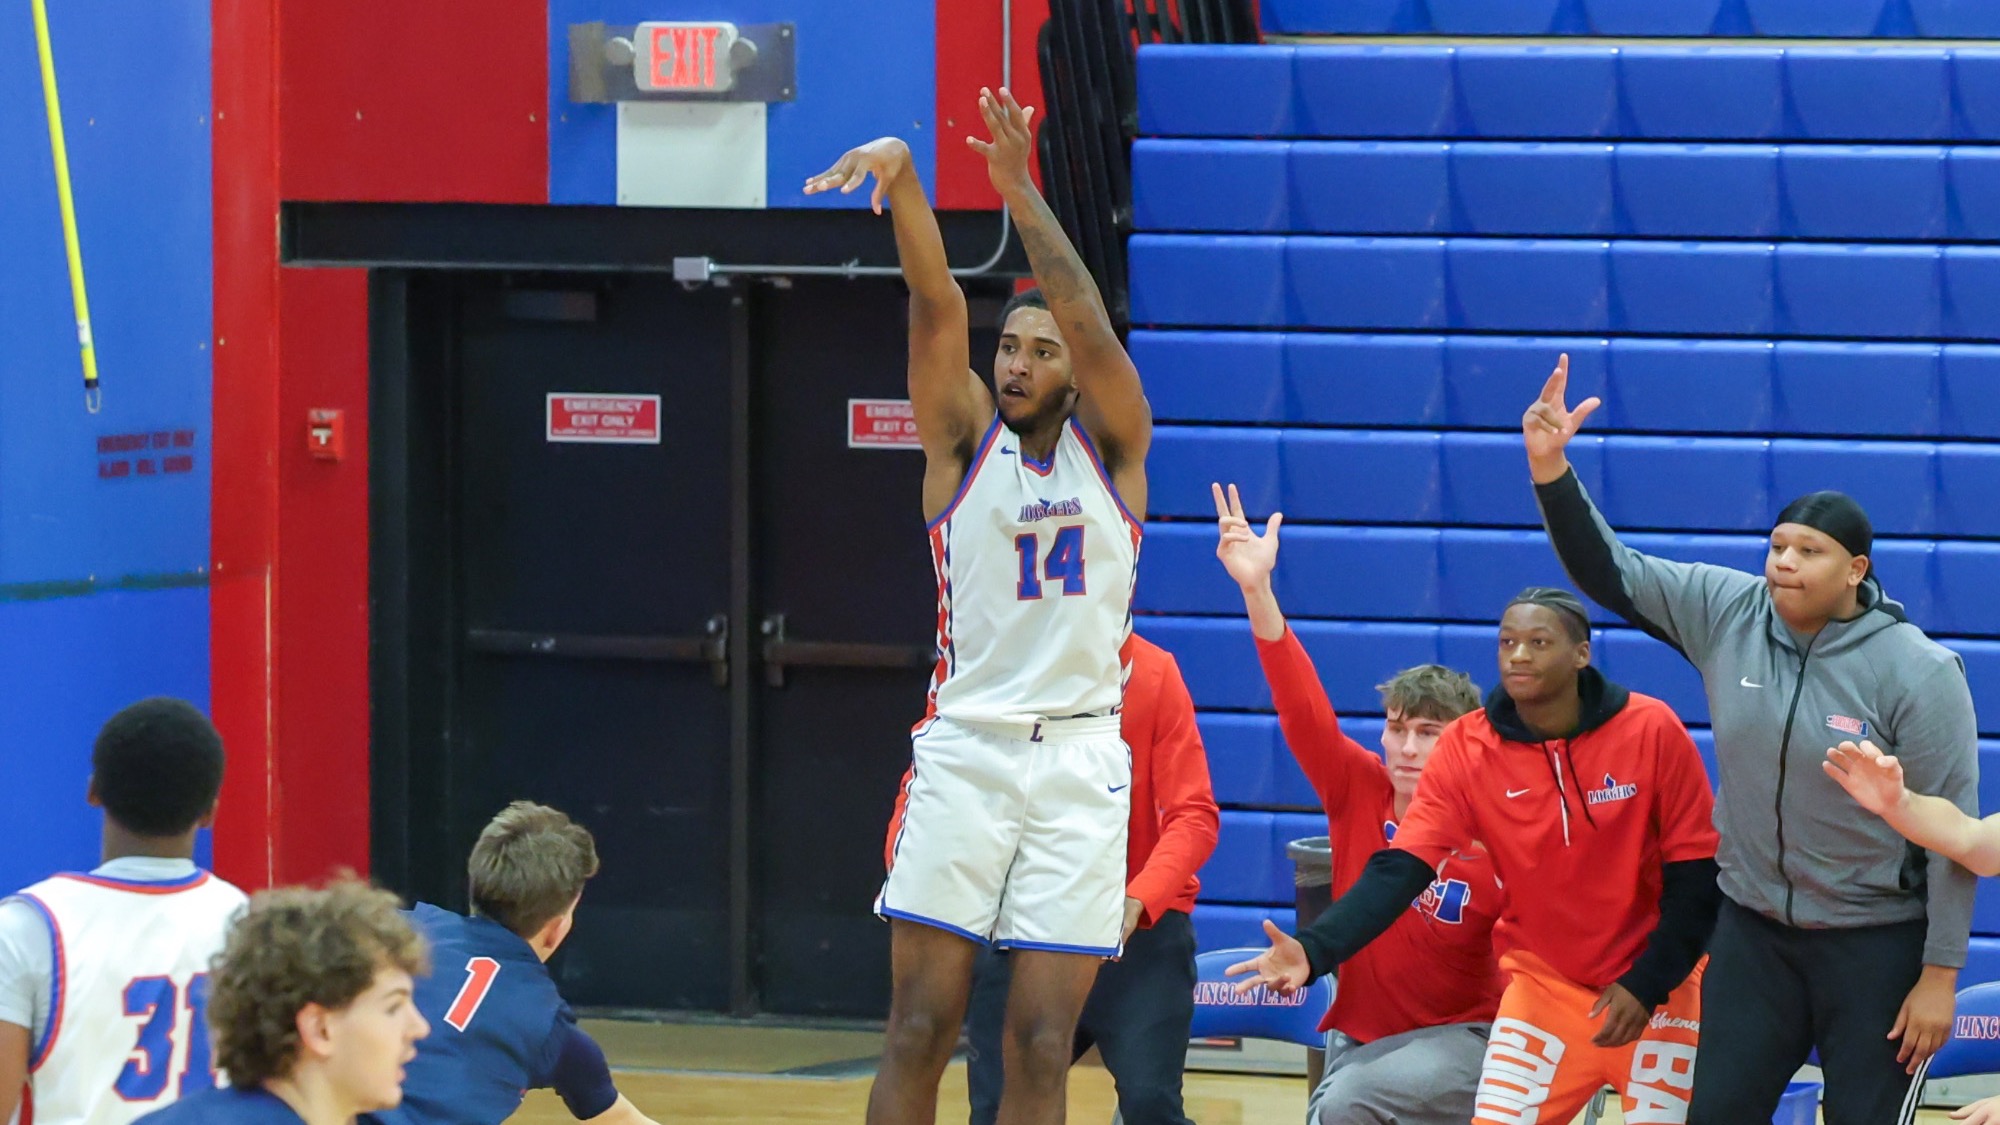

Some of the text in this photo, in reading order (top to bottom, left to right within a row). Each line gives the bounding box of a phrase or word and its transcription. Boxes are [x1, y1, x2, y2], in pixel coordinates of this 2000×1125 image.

[650, 27, 719, 88] EXIT
[563, 400, 643, 413] EMERGENCY
[571, 414, 635, 427] EXIT ONLY
[873, 420, 900, 433] EXIT
[1015, 525, 1086, 601] 14
[1030, 723, 1044, 742] L
[1588, 783, 1637, 804] LOGGERS
[444, 956, 500, 1032] 1
[113, 972, 218, 1101] 31
[1955, 1015, 2000, 1039] LINC
